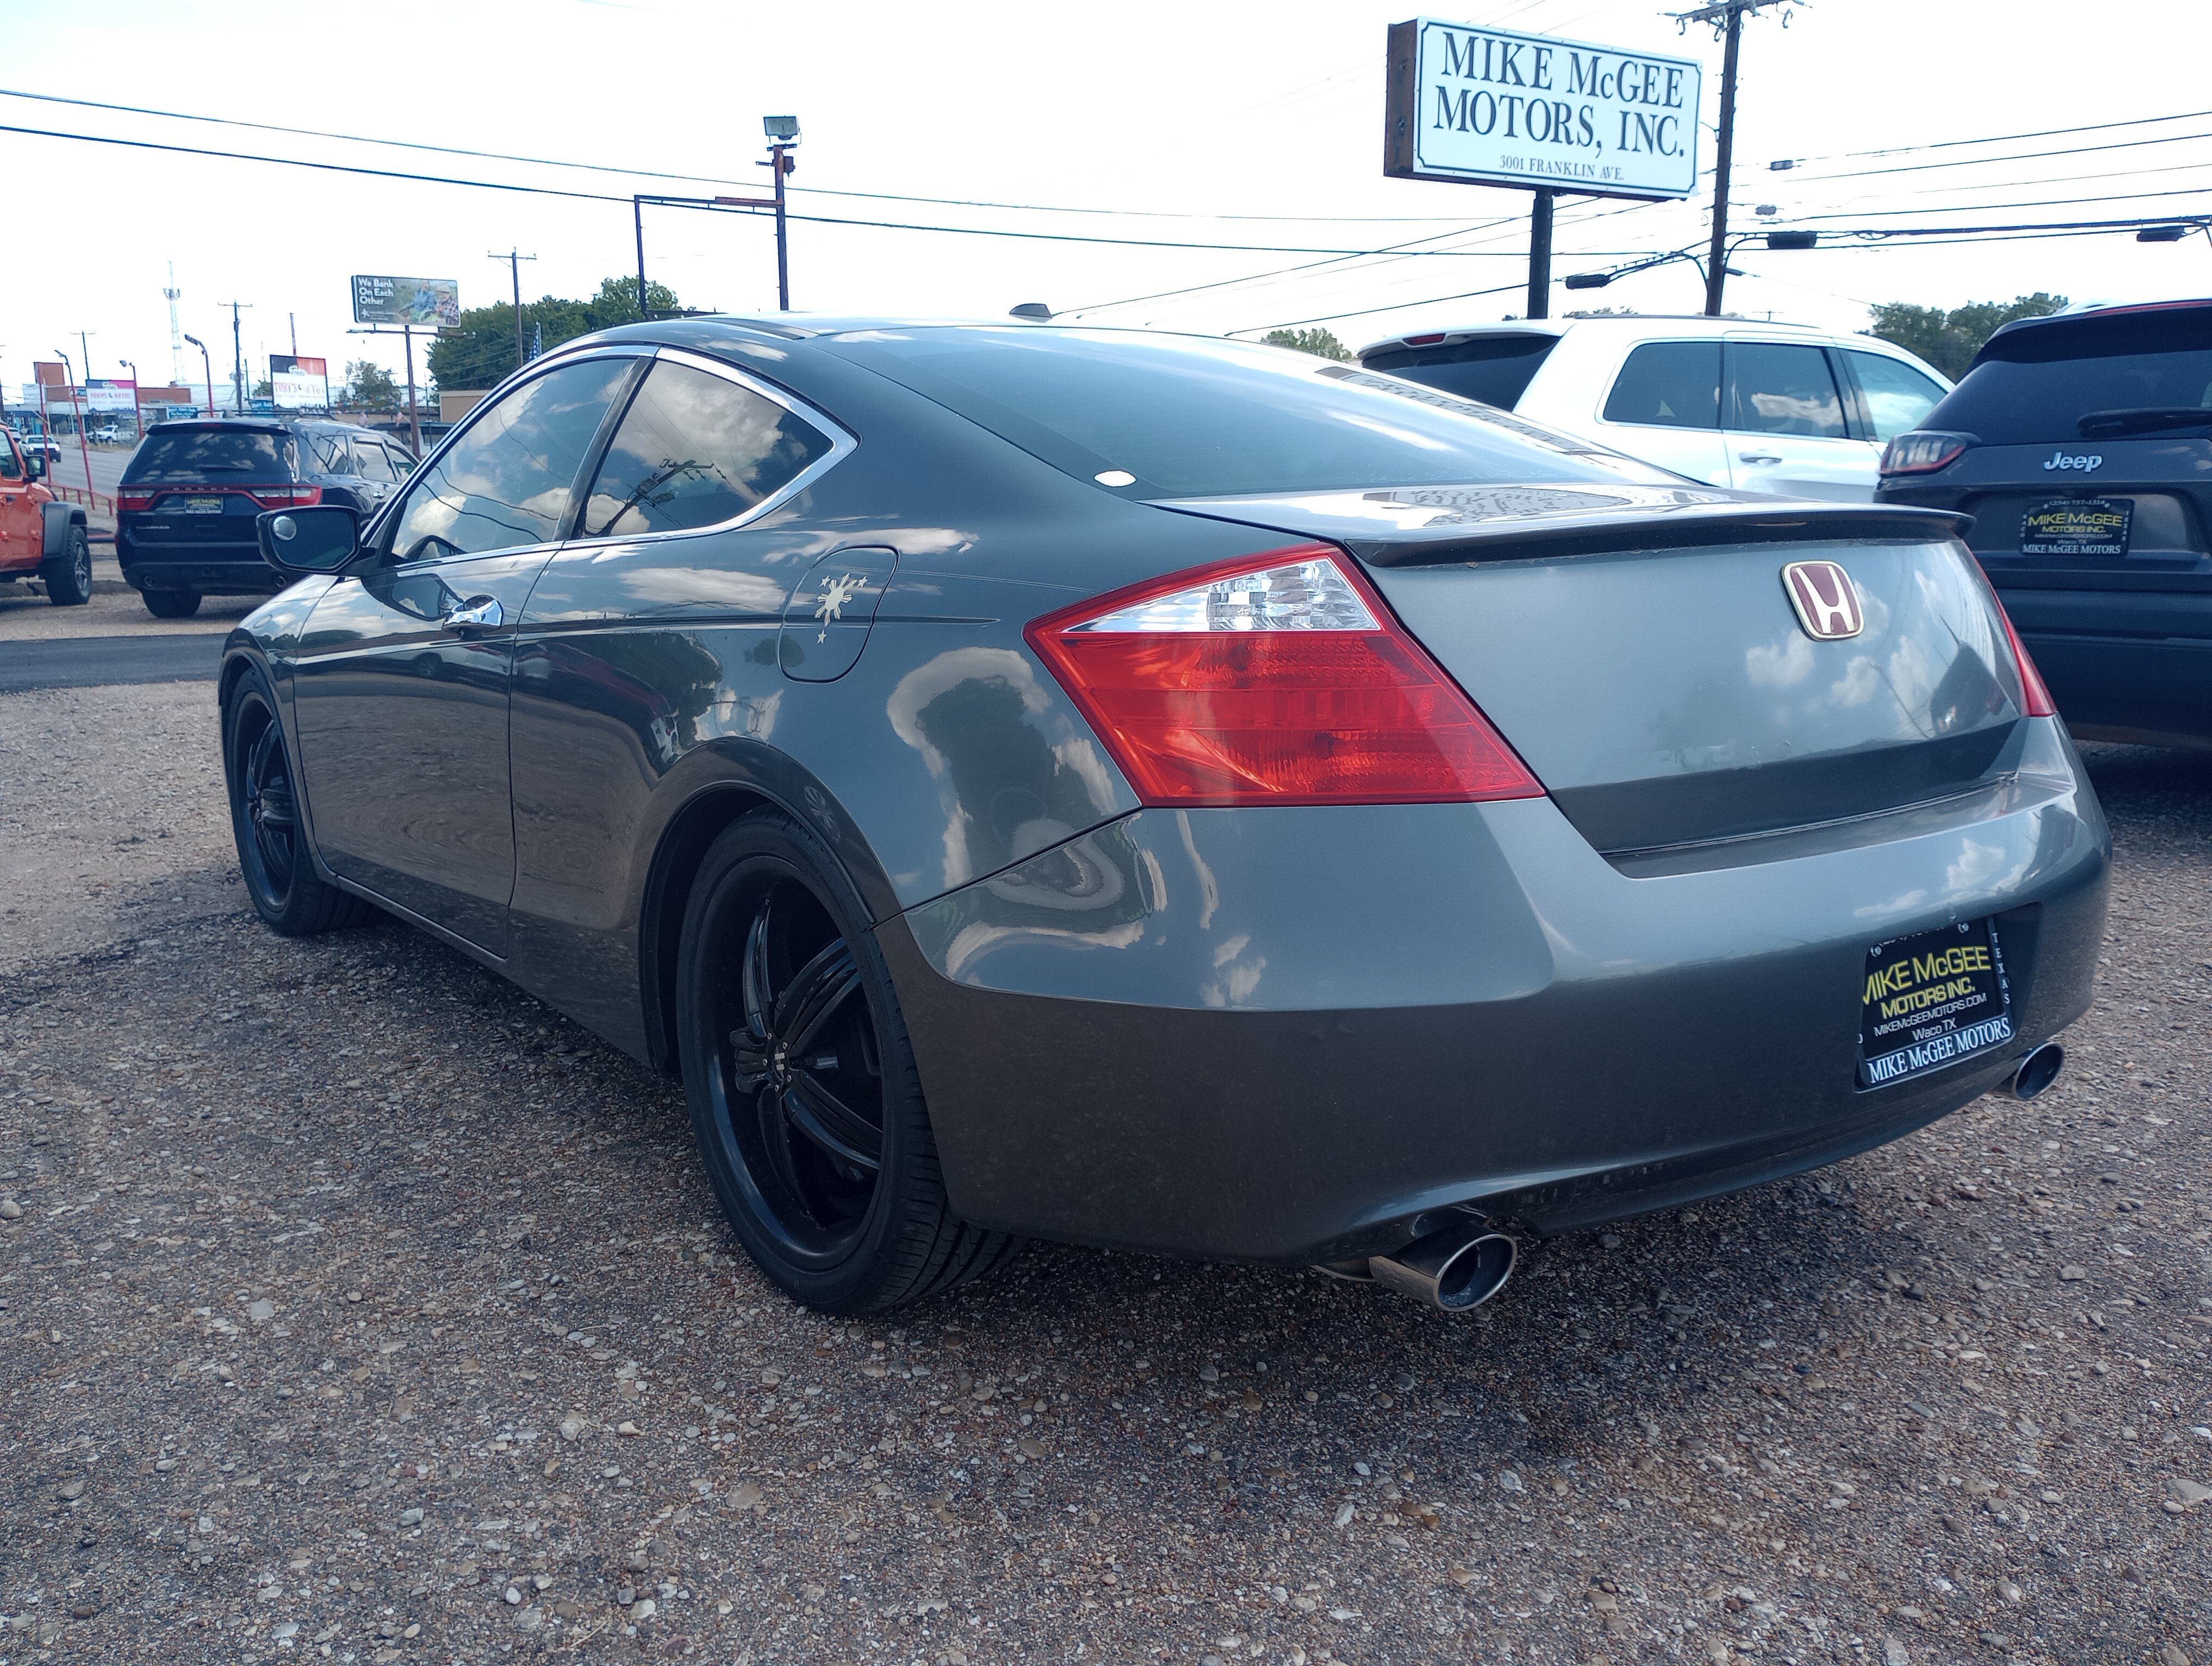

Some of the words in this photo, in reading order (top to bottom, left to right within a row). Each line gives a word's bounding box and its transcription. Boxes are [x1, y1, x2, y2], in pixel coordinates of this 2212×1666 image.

[1441, 31, 1553, 91] MIKE
[1567, 52, 1683, 108] McGEE
[1433, 85, 1602, 158] MOTORS,
[1617, 110, 1685, 157] INC.
[1500, 155, 1524, 170] 3001
[1529, 158, 1595, 178] FRANKLIN
[1599, 166, 1624, 181] AVE.
[358, 277, 372, 287] We
[373, 278, 394, 288] Bank
[358, 286, 373, 296] On
[374, 287, 394, 297] Each
[359, 296, 384, 305] Other
[2043, 452, 2102, 472] Jeep
[2028, 513, 2066, 527] MIKE
[2068, 513, 2123, 527] McGEE
[2022, 544, 2047, 553] MIKE
[2047, 544, 2079, 554] McGEE
[2080, 544, 2121, 554] MOTORS
[1863, 959, 1912, 1005] MIKE
[1912, 946, 1992, 984] McGEE
[1991, 932, 2010, 1004] TEXAS
[1880, 983, 1947, 1020] MOTORS
[1946, 976, 1976, 1000] INC.
[1911, 1027, 1943, 1042] Waco
[1941, 1017, 1957, 1032] TX
[1867, 1055, 1908, 1084] MIKE
[1906, 1036, 1956, 1070] McGEE
[1953, 1017, 2011, 1053] MOTORS
